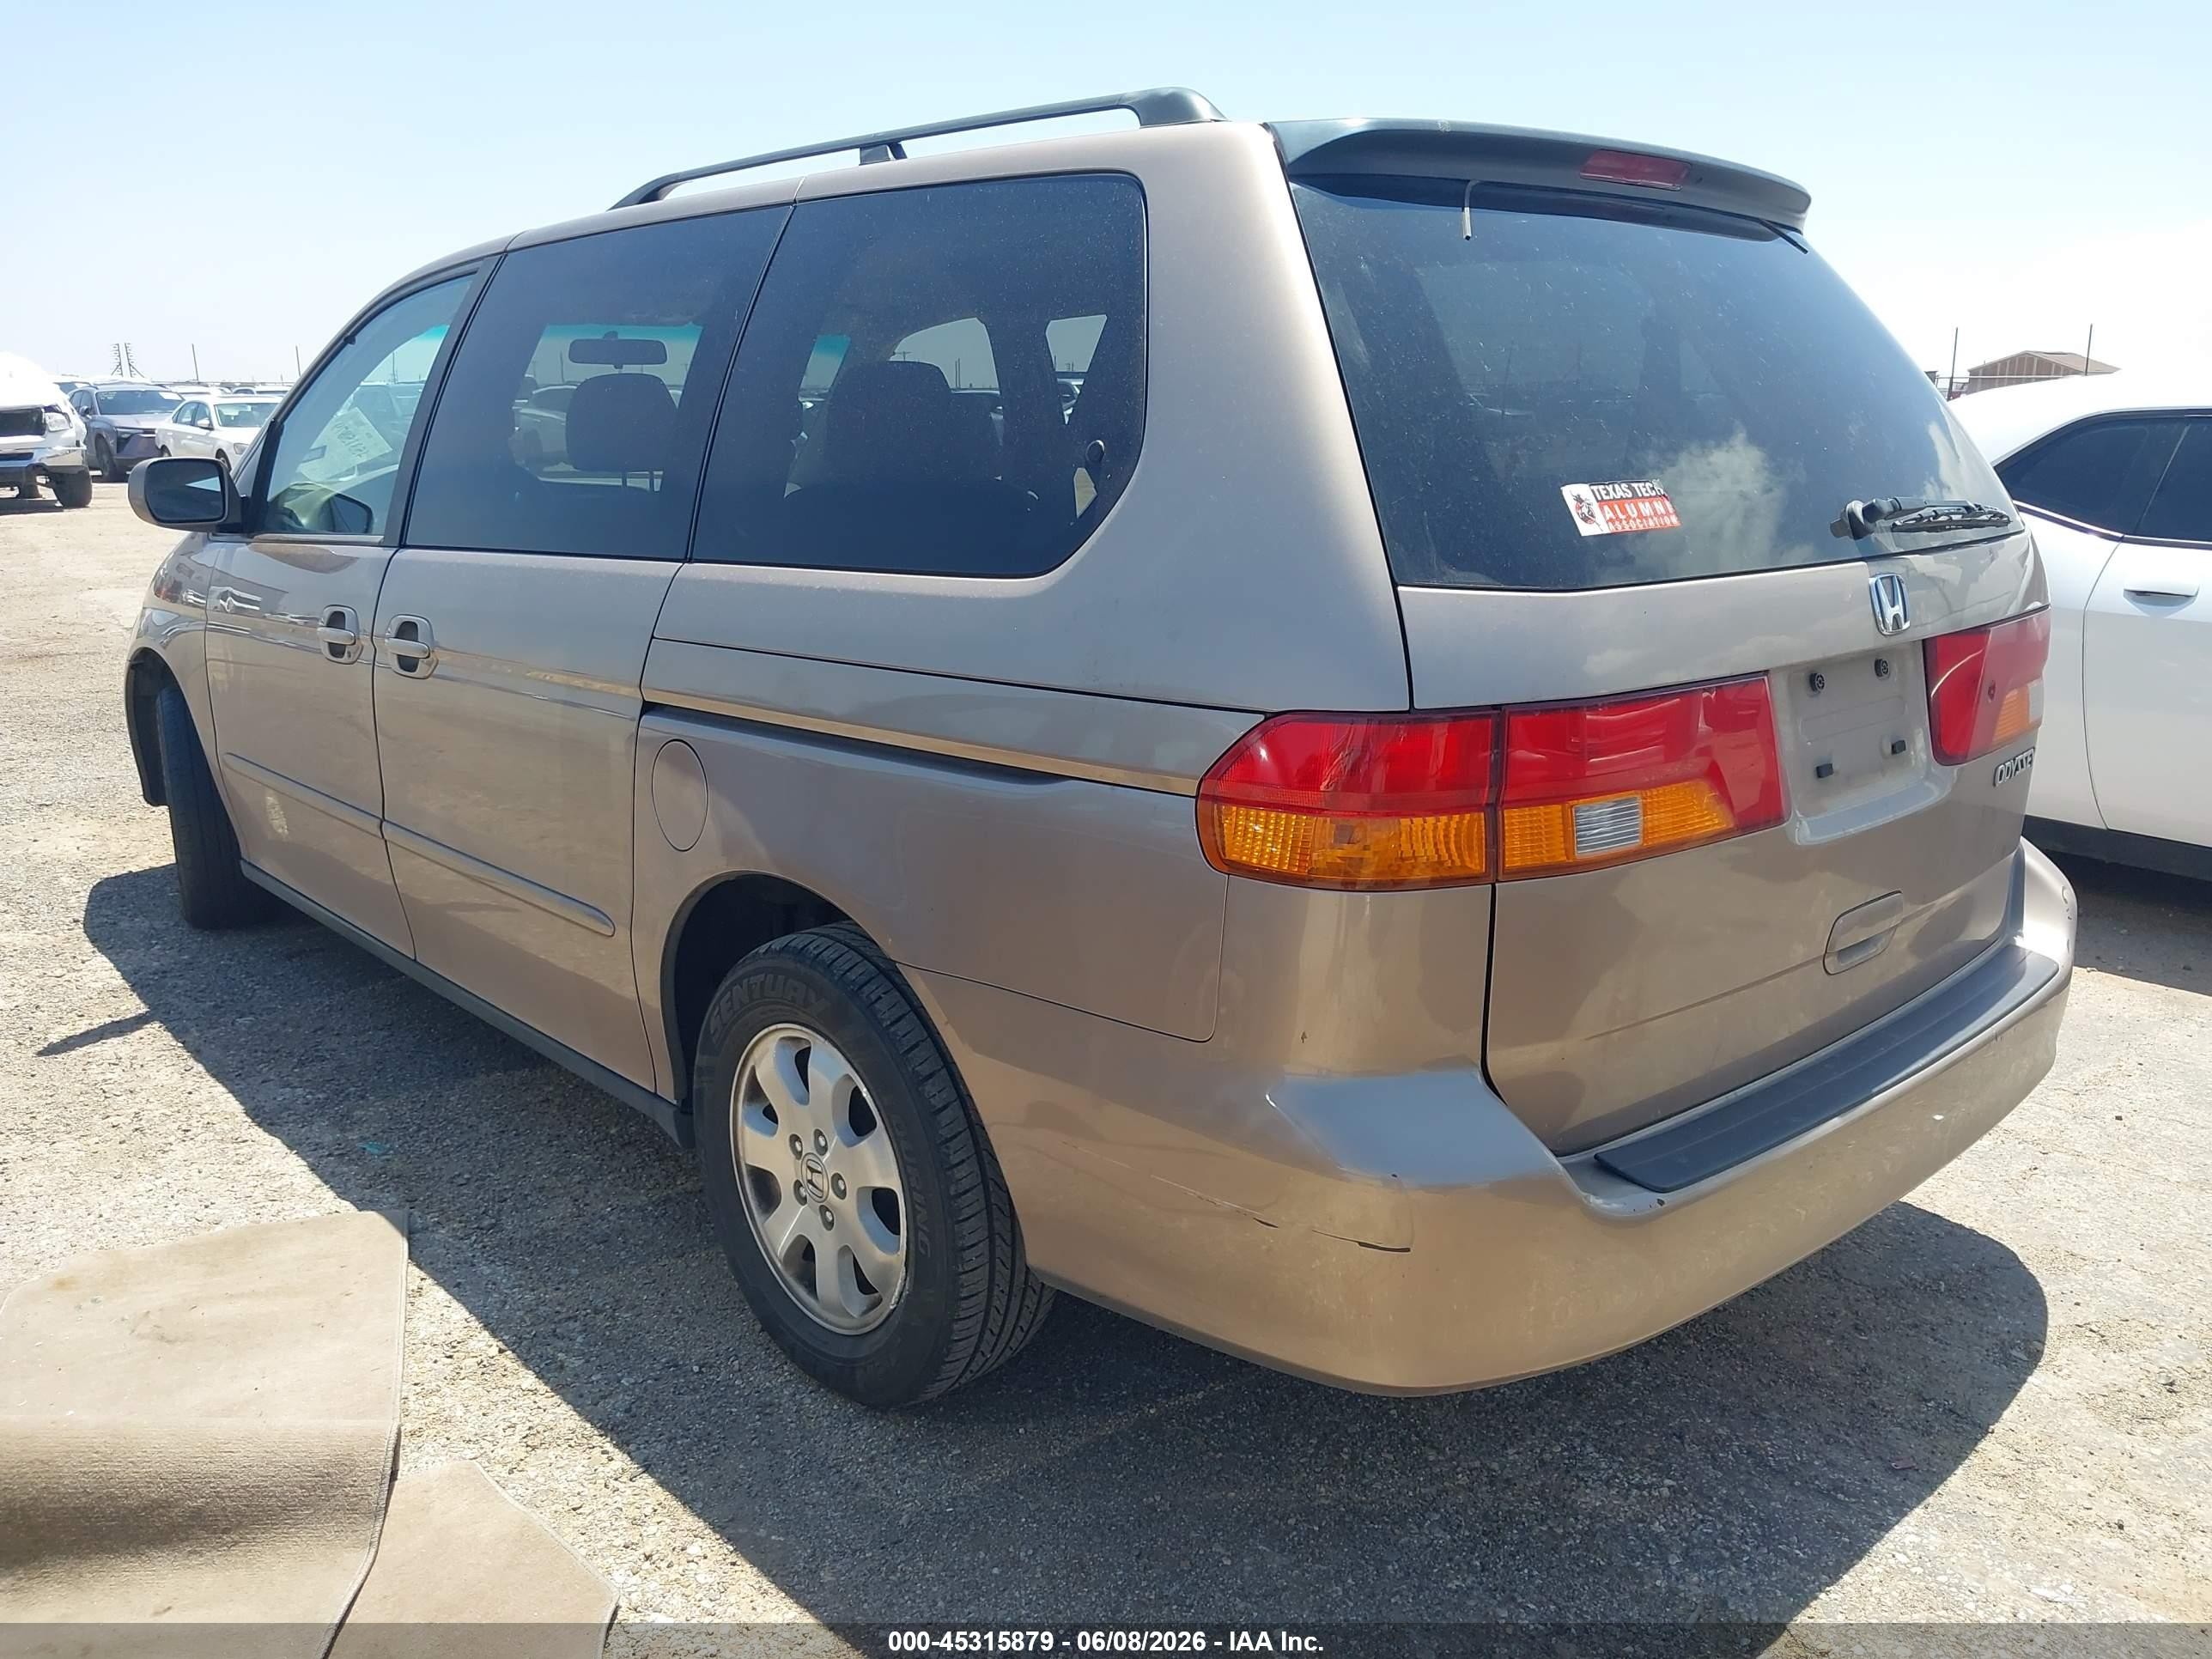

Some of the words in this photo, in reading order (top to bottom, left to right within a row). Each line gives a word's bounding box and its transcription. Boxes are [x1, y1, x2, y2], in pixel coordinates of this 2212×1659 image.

[1590, 483, 1632, 501] TEXAS
[1632, 482, 1664, 498] TECH
[1604, 500, 1674, 520] ALUMNI
[1607, 514, 1678, 532] ASSOCIATION
[709, 973, 833, 1045] SENTURY
[878, 1094, 931, 1258] OURING
